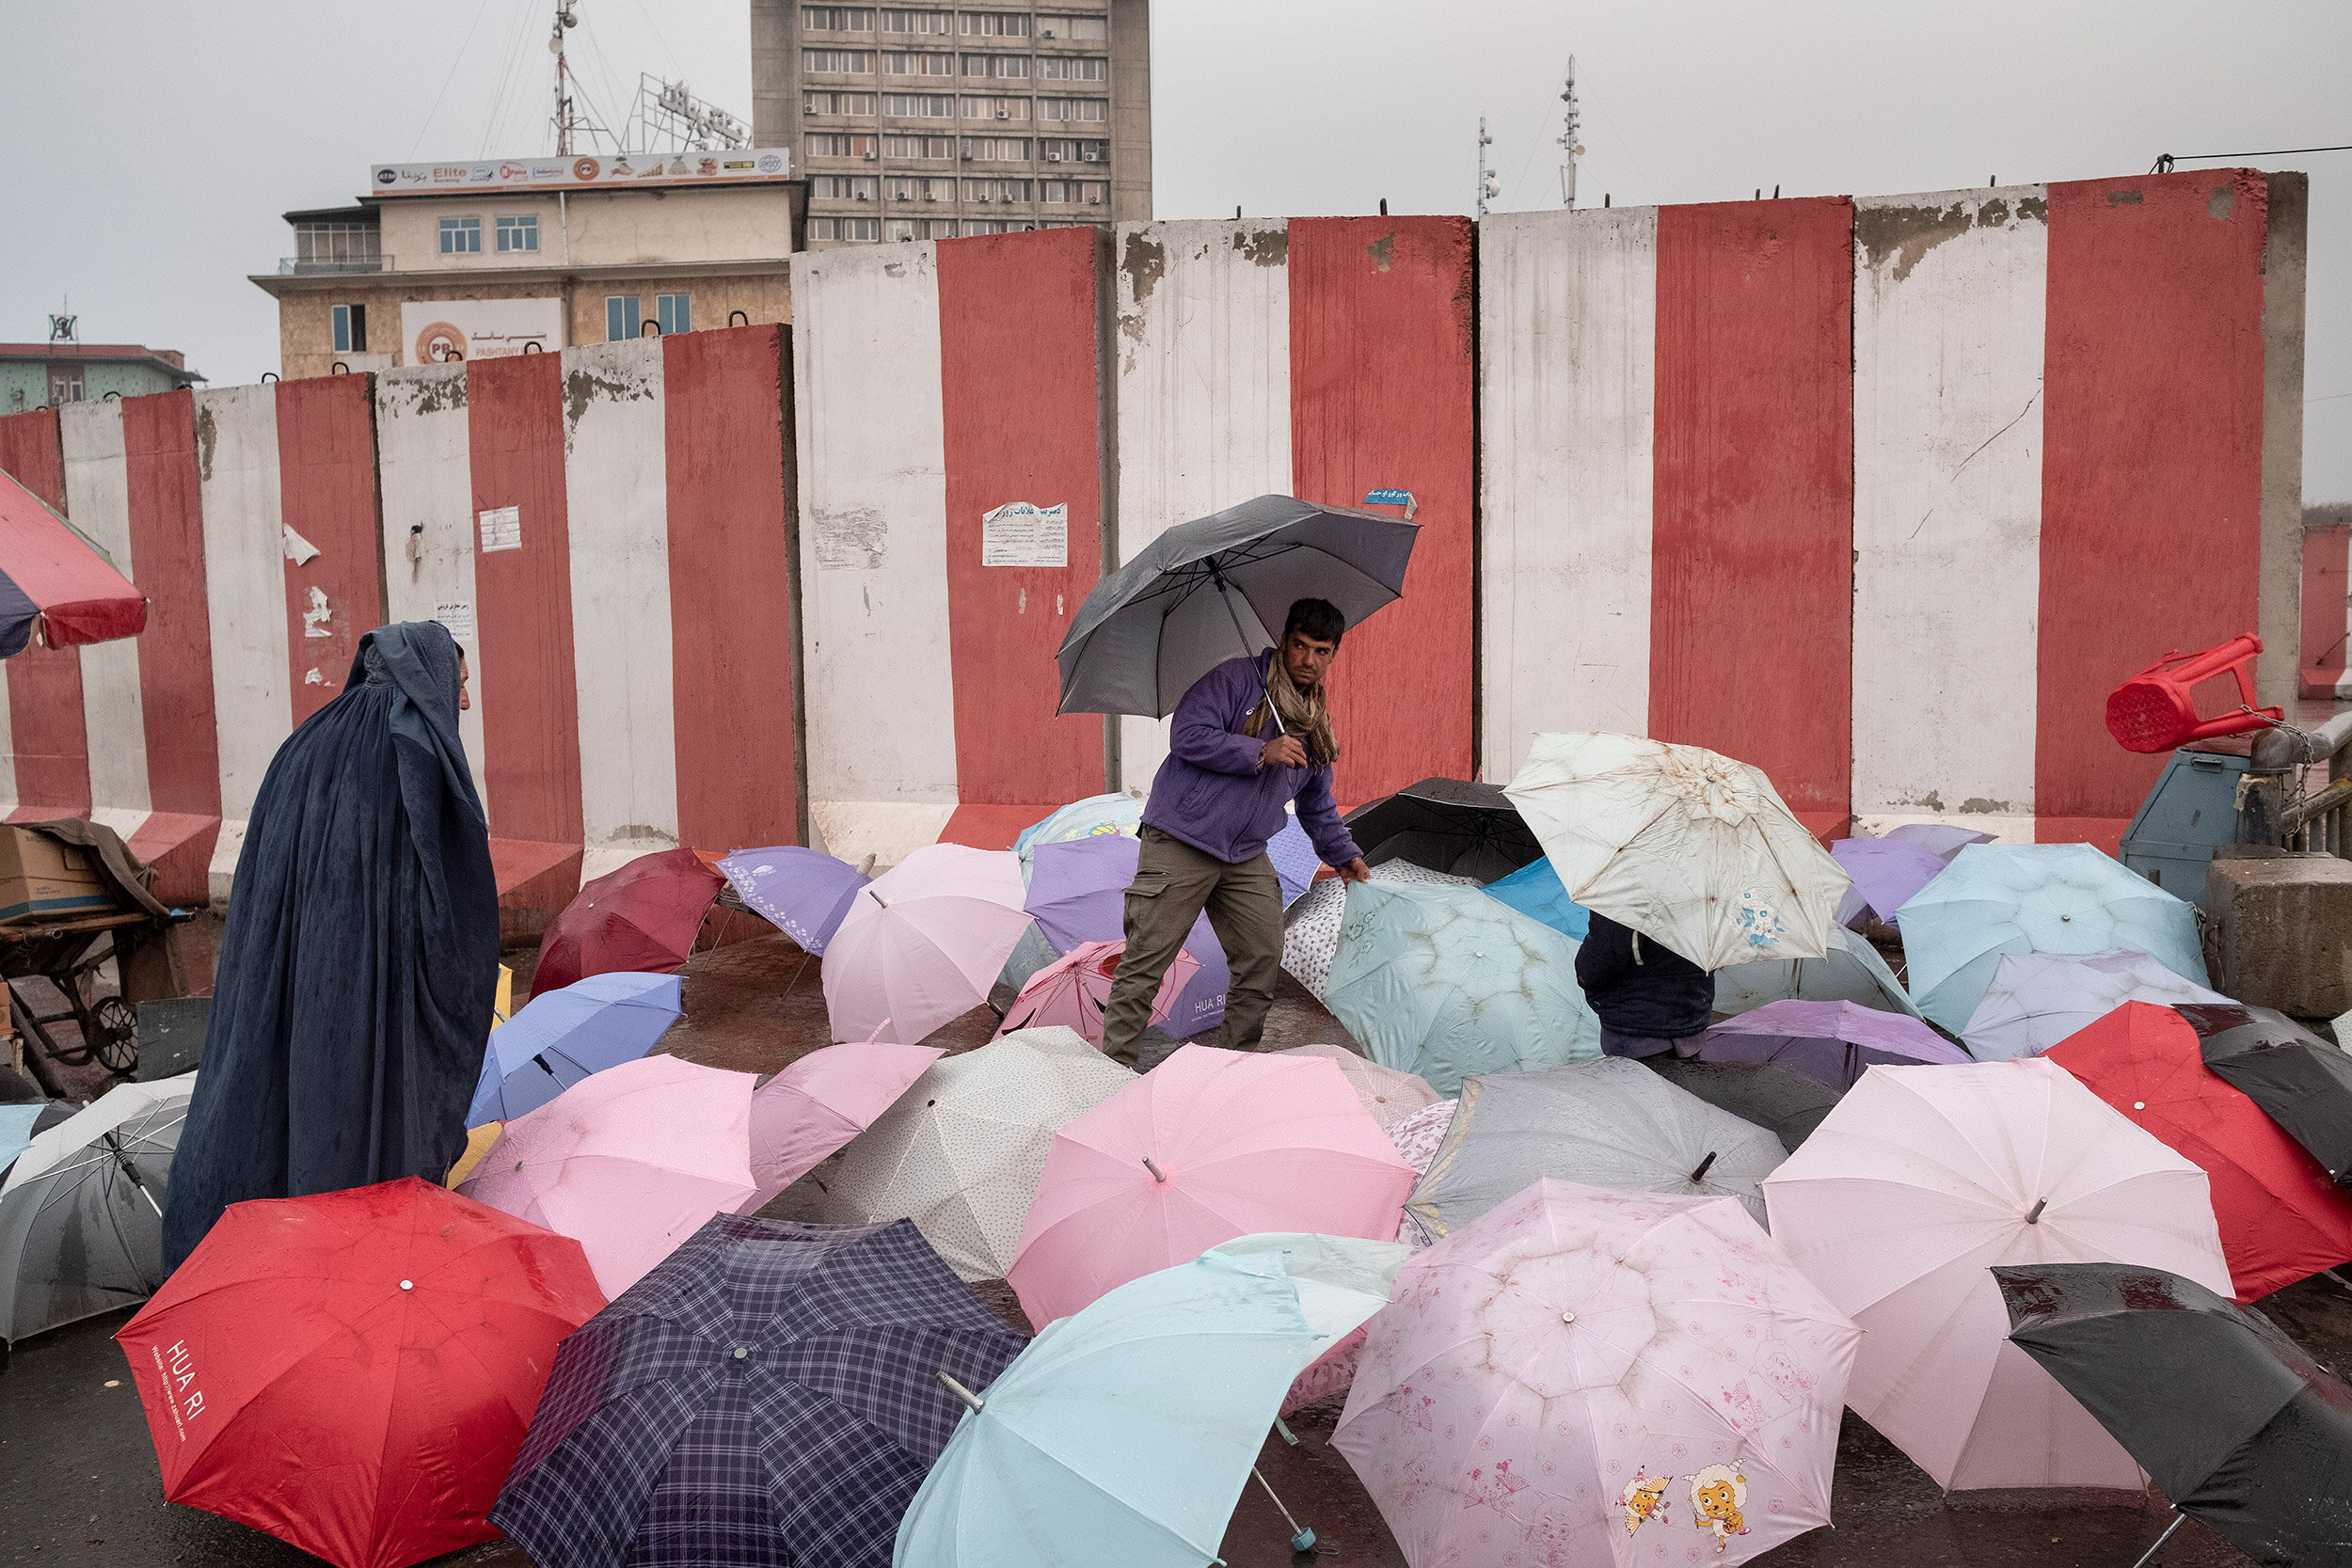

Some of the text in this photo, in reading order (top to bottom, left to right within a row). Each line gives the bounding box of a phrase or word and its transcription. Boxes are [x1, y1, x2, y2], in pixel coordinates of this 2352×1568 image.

[434, 167, 468, 178] Elite
[432, 343, 451, 355] PB
[1195, 994, 1226, 1014] HUA RI
[151, 1345, 165, 1372] Website:
[167, 1339, 206, 1421] HUA RI
